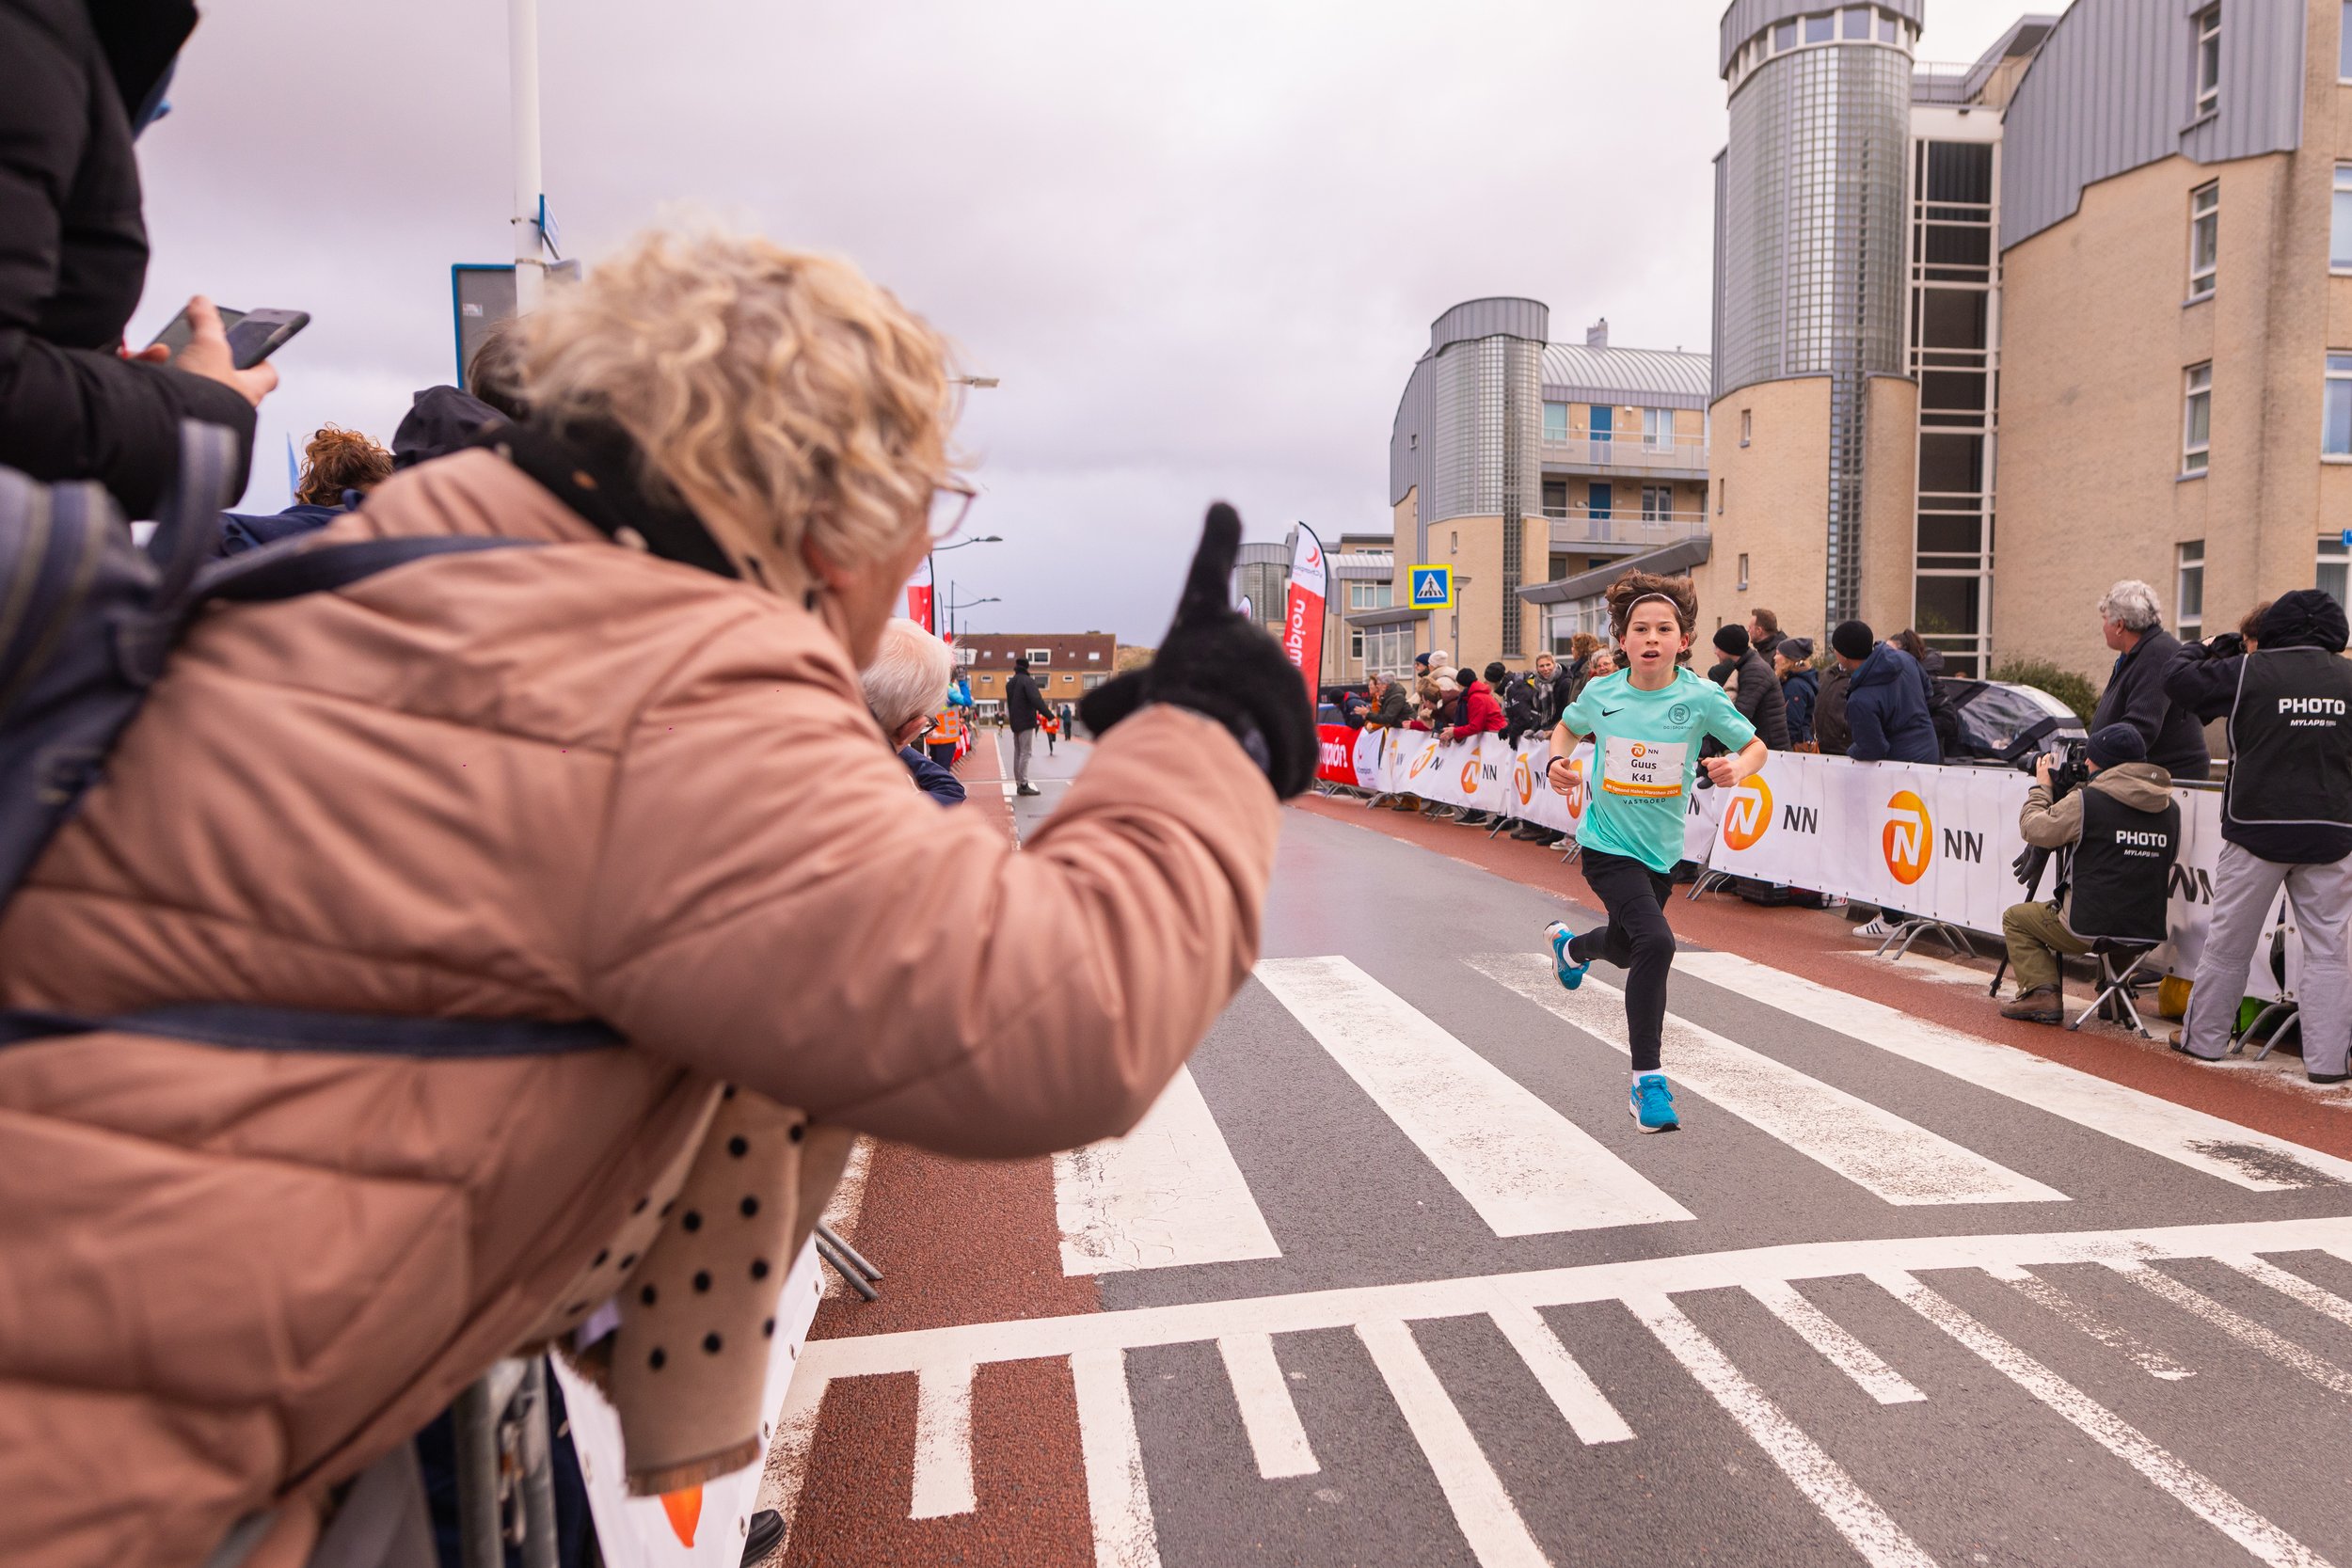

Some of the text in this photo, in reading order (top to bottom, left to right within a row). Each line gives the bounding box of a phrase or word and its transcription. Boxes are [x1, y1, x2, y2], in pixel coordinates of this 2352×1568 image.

[2279, 698, 2345, 715] PHOTO
[2290, 719, 2326, 727] MYLAPS
[1482, 764, 1498, 781] NN
[1630, 759, 1657, 769] Guus
[1631, 773, 1653, 783] K41
[1783, 804, 1818, 834] NN
[1944, 828, 1983, 863] NN
[2116, 830, 2168, 847] PHOTO
[2123, 849, 2151, 858] MYLAPS
